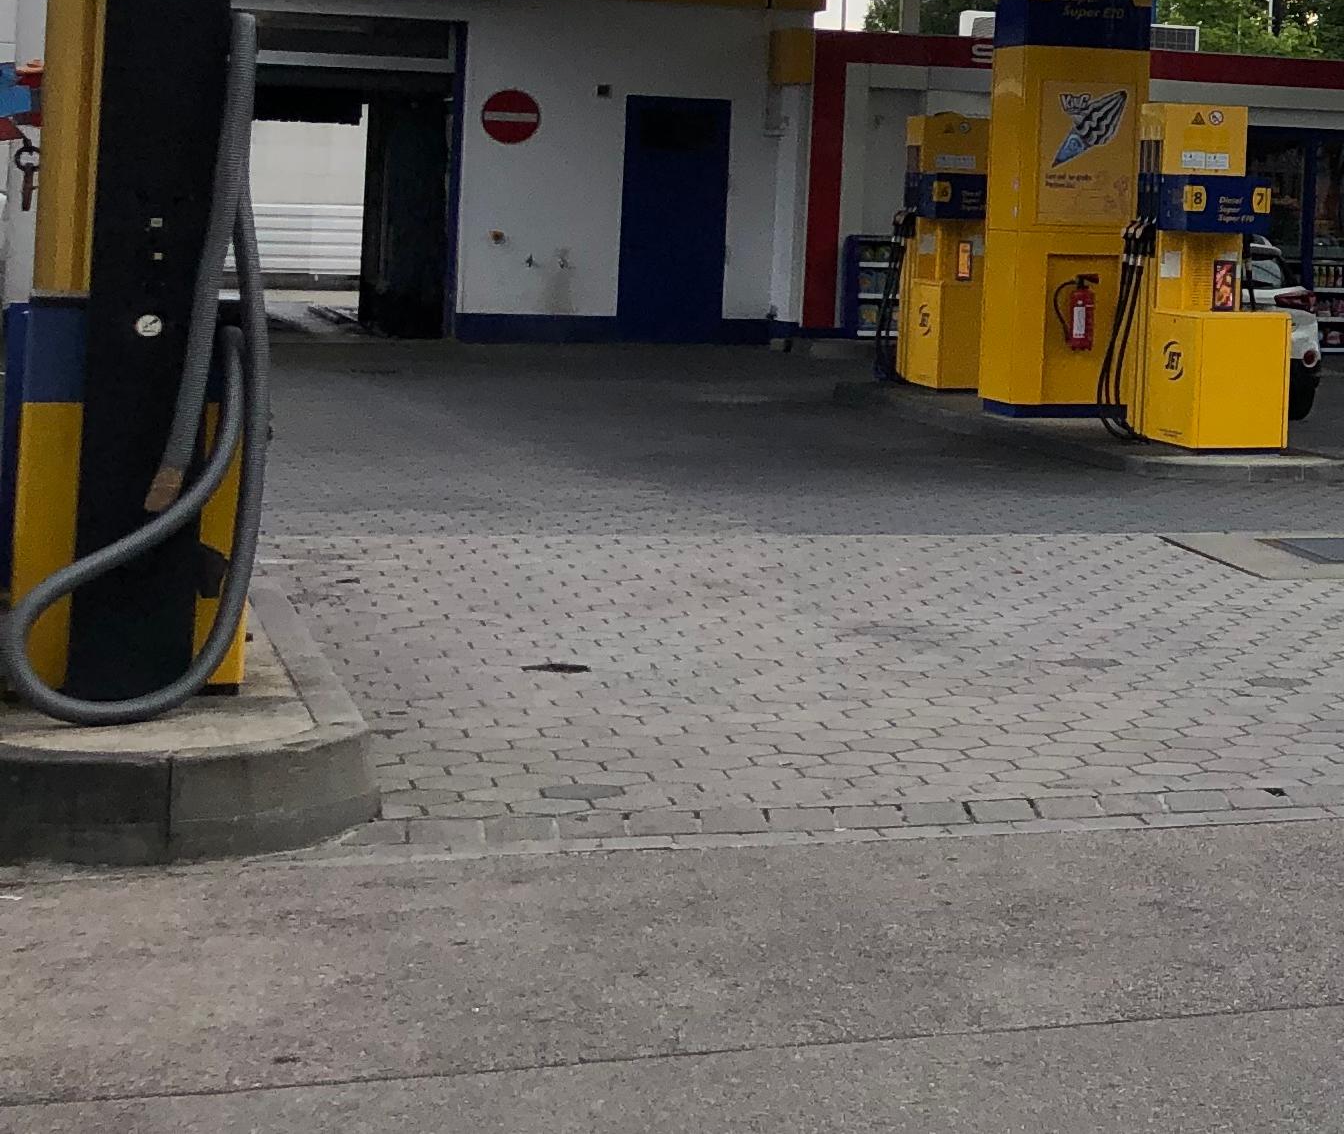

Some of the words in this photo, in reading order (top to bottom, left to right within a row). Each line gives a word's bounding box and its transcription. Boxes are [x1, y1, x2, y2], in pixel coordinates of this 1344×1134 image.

[1062, 5, 1101, 19] Super
[1193, 192, 1203, 205] 8
[1256, 192, 1265, 206] 7
